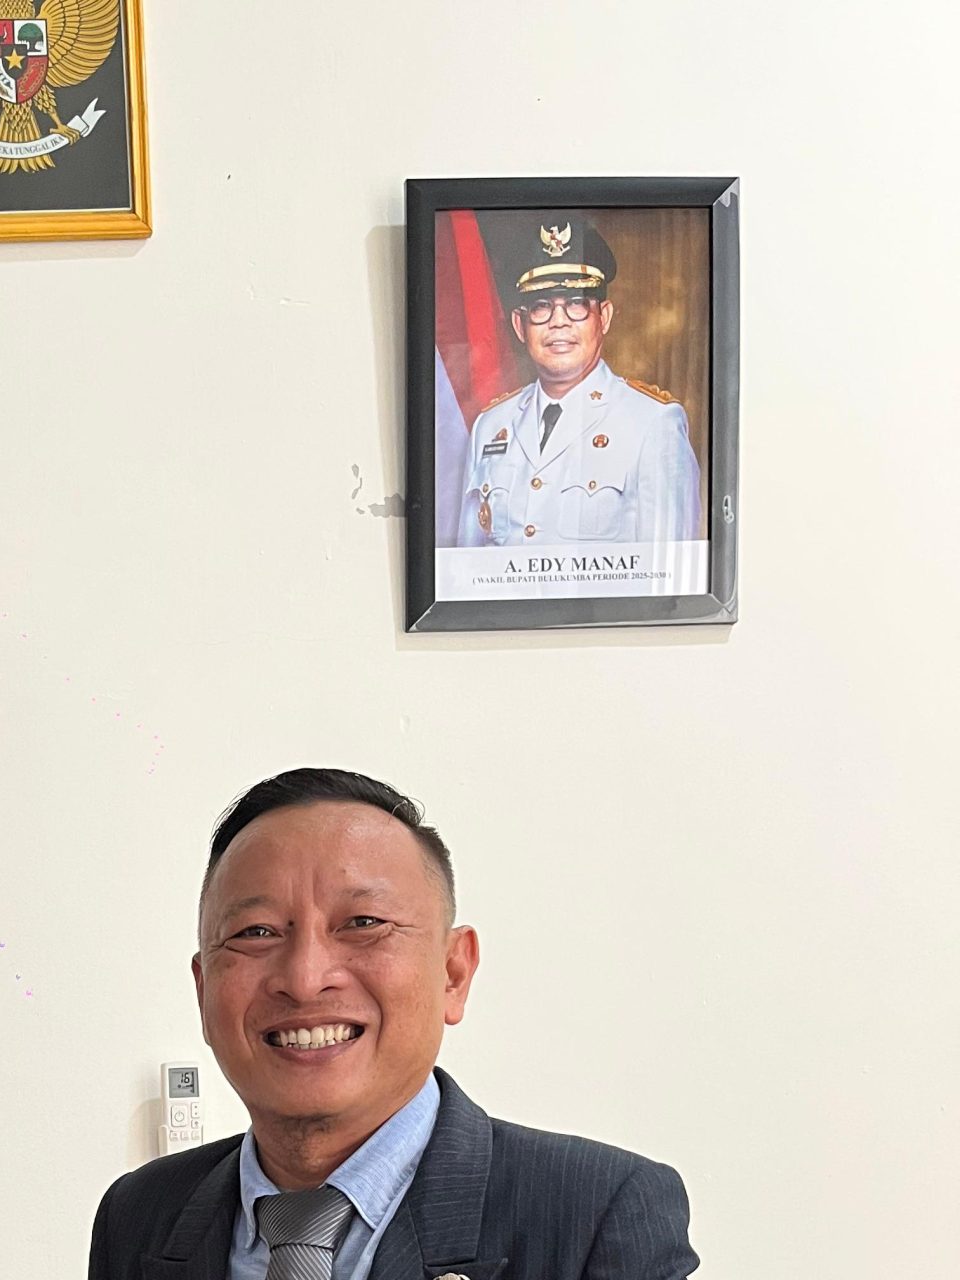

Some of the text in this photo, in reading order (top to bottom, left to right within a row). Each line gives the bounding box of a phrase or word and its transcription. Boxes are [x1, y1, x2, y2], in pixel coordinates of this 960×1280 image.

[14, 143, 50, 155] TUNGGAL
[50, 136, 65, 147] IKA
[504, 555, 640, 573] A. EDY MANAF
[477, 576, 505, 584] WAKIL
[506, 575, 536, 583] BUPATI
[537, 574, 591, 582] BULUKUMBA
[592, 573, 630, 581] PERIODE
[631, 572, 667, 580] 2025-2030
